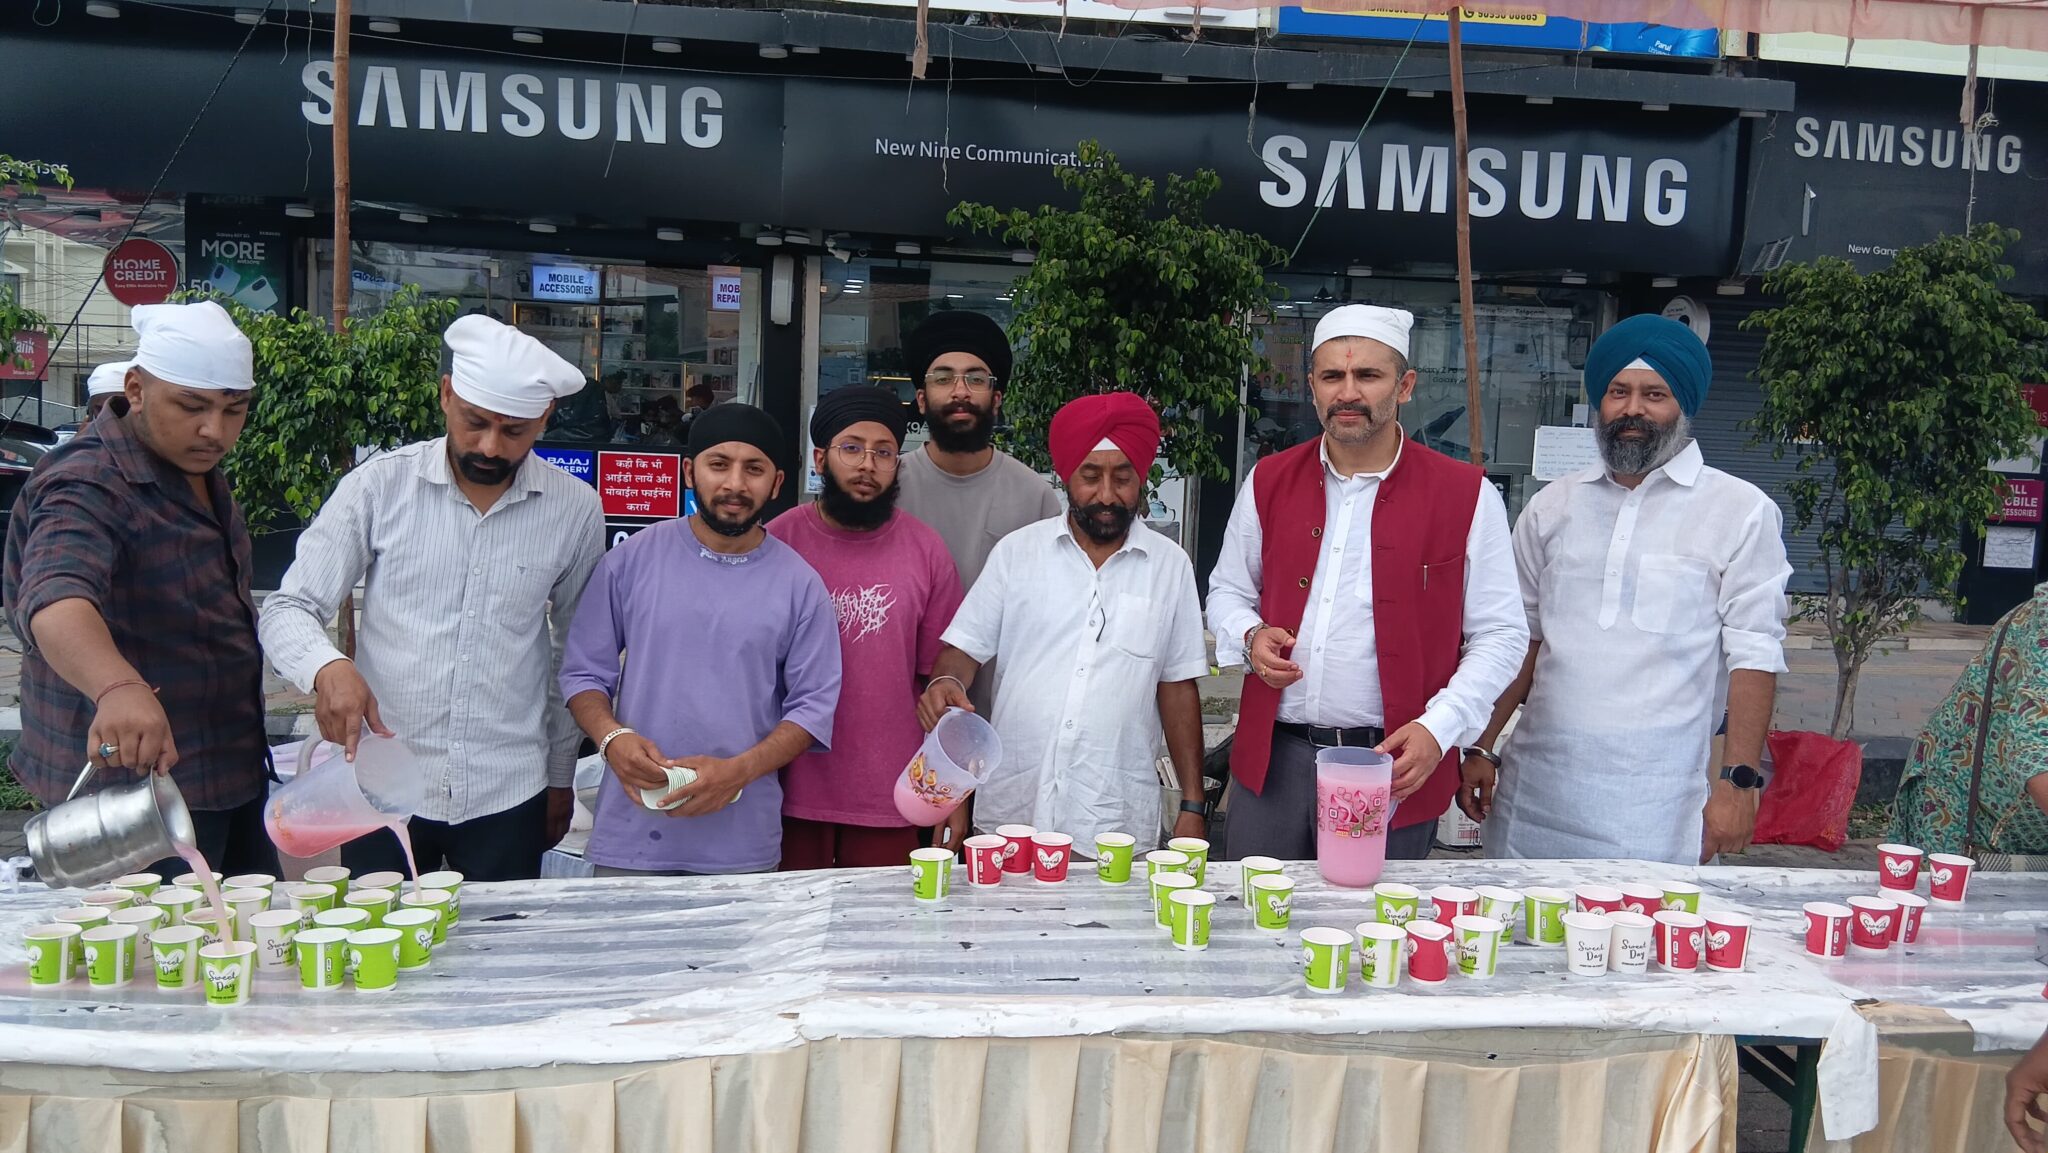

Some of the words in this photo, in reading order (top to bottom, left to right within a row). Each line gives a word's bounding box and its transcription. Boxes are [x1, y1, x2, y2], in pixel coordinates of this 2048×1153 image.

[301, 60, 723, 148] SAMSUNG
[875, 138, 915, 157] New
[920, 141, 961, 160] Nine
[1794, 117, 2022, 174] SAMSUNG
[1259, 134, 1689, 227] SAMSUNG
[201, 239, 265, 260] MORE
[1848, 244, 1871, 254] New
[113, 259, 161, 269] HOME
[114, 270, 167, 281] CREDIT
[548, 273, 585, 284] MOBILE
[539, 283, 594, 294] ACCESSORIES
[716, 294, 741, 304] REPAI
[547, 457, 590, 466] BAJAJ
[1385, 909, 1409, 919] Sweet
[267, 937, 294, 950] Sweet
[1456, 939, 1480, 953] Sweet
[1578, 941, 1604, 951] Sweet
[1621, 939, 1646, 950] Sweet
[276, 947, 293, 958] Day
[1461, 951, 1477, 964] Day
[1586, 951, 1603, 962] Day
[1629, 949, 1645, 960] Day
[162, 966, 181, 977] Day
[208, 970, 237, 982] Sweet
[217, 982, 236, 992] Day
